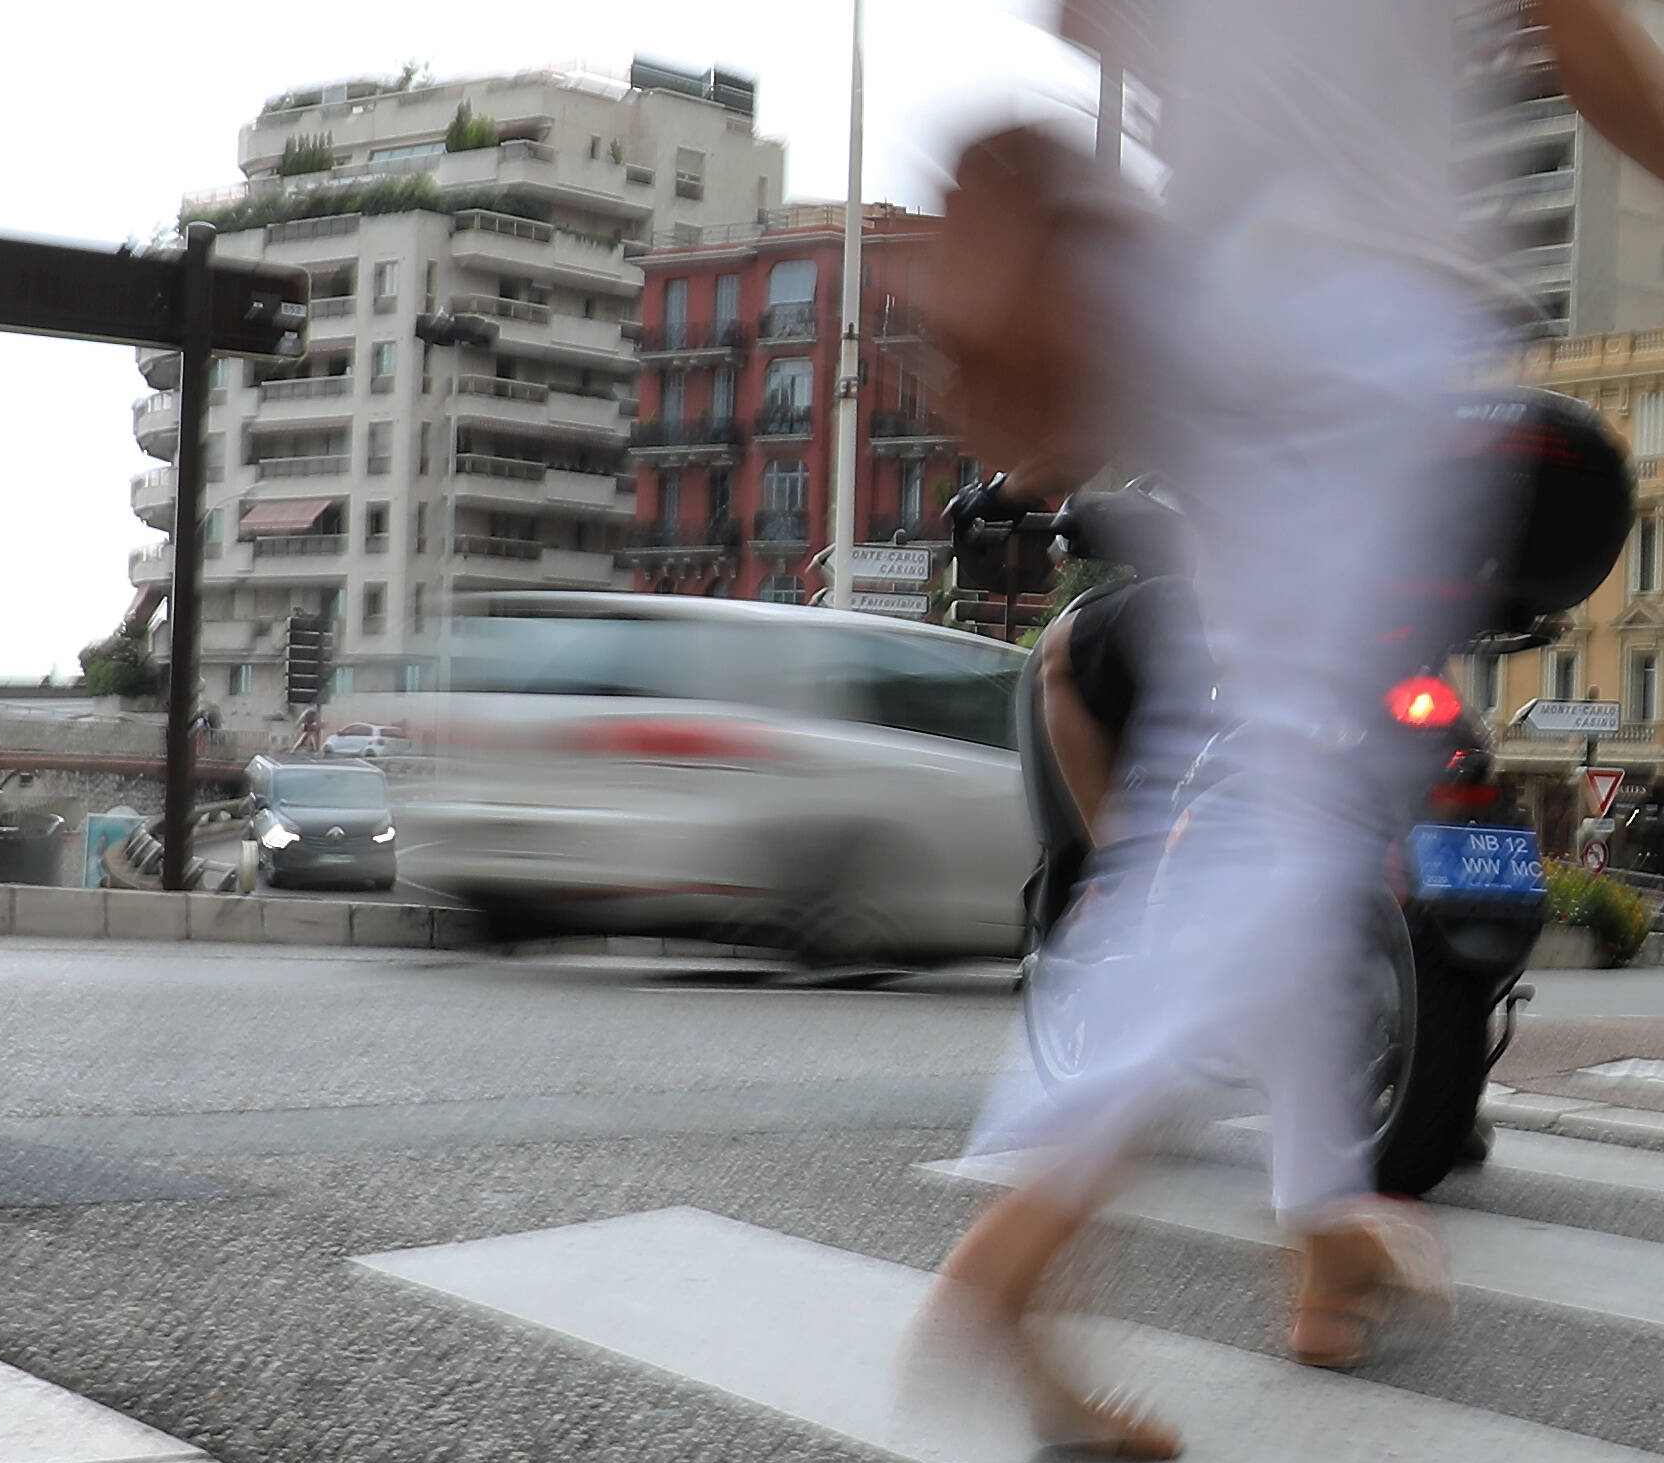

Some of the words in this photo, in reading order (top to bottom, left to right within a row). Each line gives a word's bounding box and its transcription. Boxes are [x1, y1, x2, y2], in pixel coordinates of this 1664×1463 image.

[852, 550, 925, 562] ONTE-CARLO
[880, 564, 925, 574] CASINO
[860, 595, 922, 608] Ferroviaire
[1541, 705, 1616, 716] MONTE-CARLO
[1576, 717, 1616, 727] CASINO
[1470, 834, 1499, 851] NB
[1506, 837, 1528, 853] 12
[1462, 857, 1500, 875] WW
[1512, 860, 1543, 877] MC
